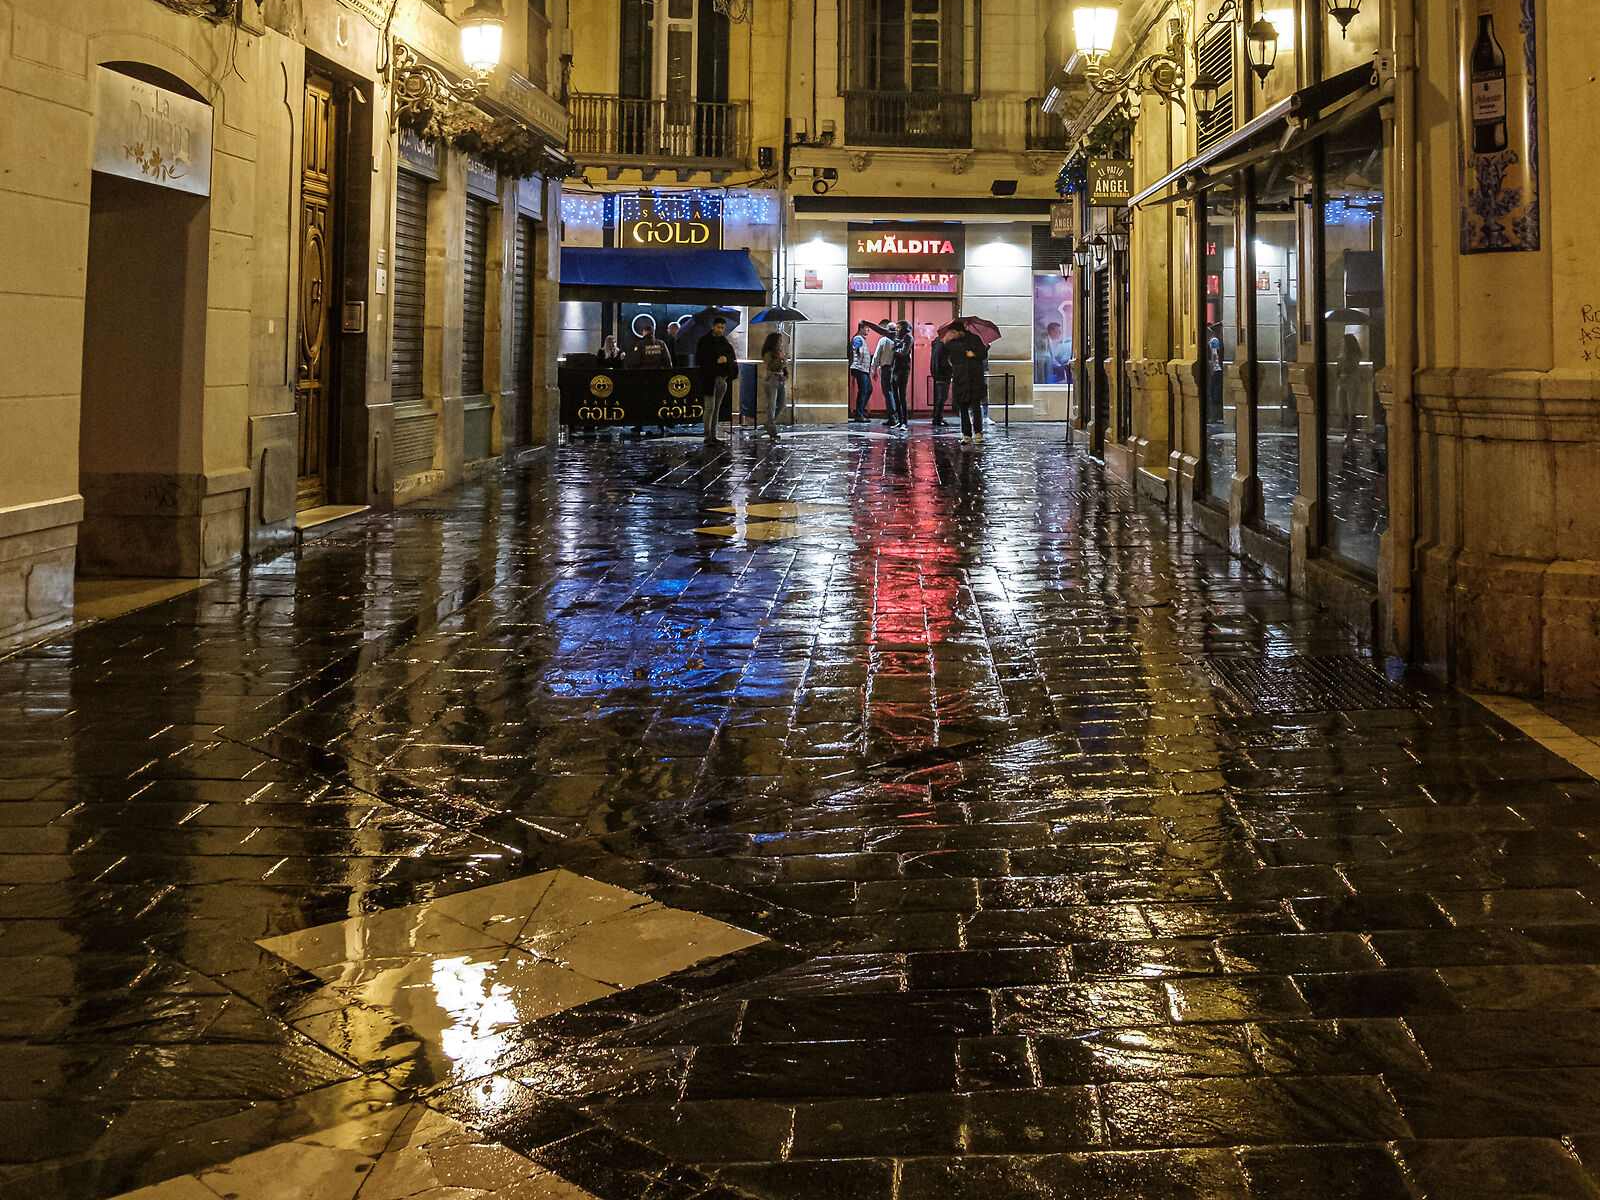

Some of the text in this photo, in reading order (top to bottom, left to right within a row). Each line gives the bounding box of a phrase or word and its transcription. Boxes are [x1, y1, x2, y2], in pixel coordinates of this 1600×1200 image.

[1106, 165, 1125, 177] PATIO
[1095, 177, 1129, 193] ÁNGEL
[642, 209, 701, 219] SALA
[633, 221, 710, 243] GOLD
[577, 406, 625, 420] GOLD
[657, 405, 704, 419] GOLD
